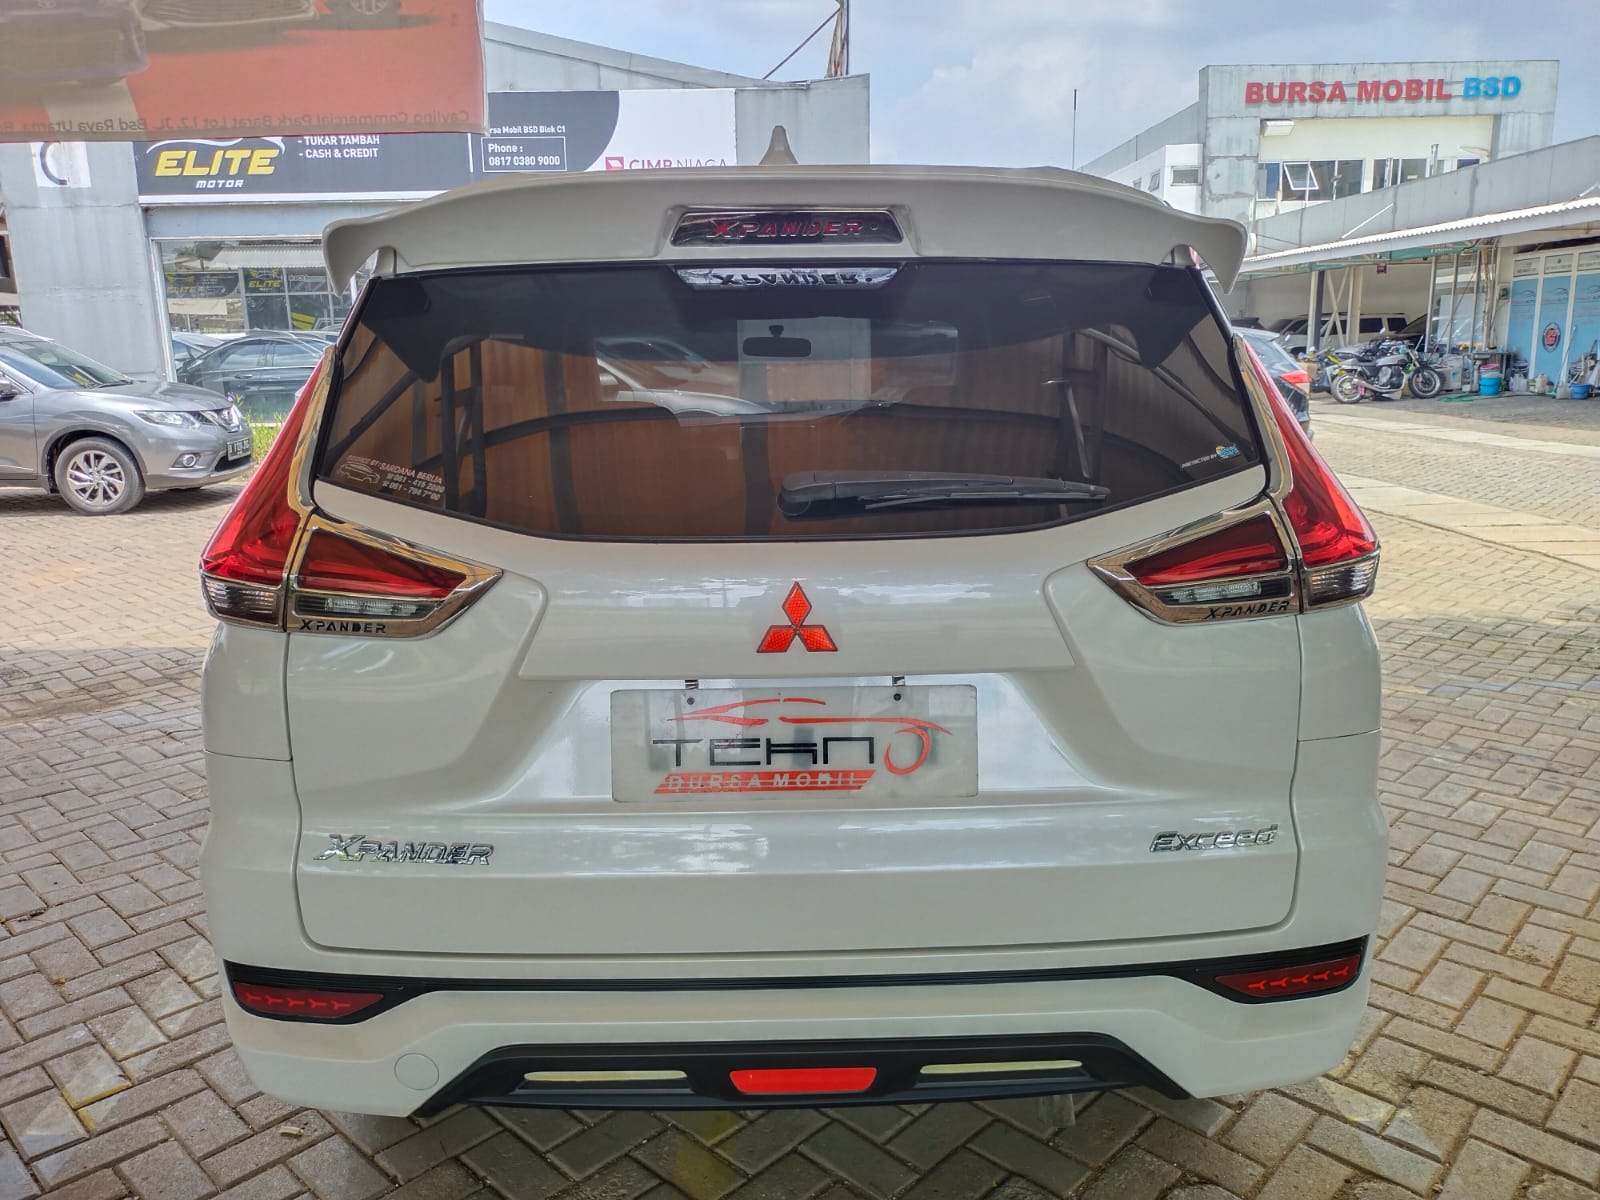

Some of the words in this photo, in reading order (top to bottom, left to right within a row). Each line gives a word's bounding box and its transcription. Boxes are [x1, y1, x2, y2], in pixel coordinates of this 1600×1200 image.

[1244, 81, 1348, 104] BURSA
[1357, 79, 1452, 103] MOBIL
[1463, 76, 1521, 100] BSD
[502, 126, 522, 134] Mobil
[304, 136, 338, 146] TUKAR
[338, 134, 380, 144] TAMBAH
[305, 148, 332, 158] CASH
[334, 149, 342, 158] &
[343, 148, 379, 158] CREDIT
[488, 144, 518, 152] Phone
[155, 148, 281, 176] ELITE
[488, 156, 511, 166] 0817
[513, 156, 536, 166] 0380
[538, 156, 560, 166] 9000
[195, 180, 244, 188] MOTOR
[706, 219, 863, 239] XPANDER
[1204, 600, 1290, 620] XPANDER
[300, 620, 386, 634] XPANDER
[667, 774, 761, 792] BURSA
[313, 834, 495, 866] XPANDER
